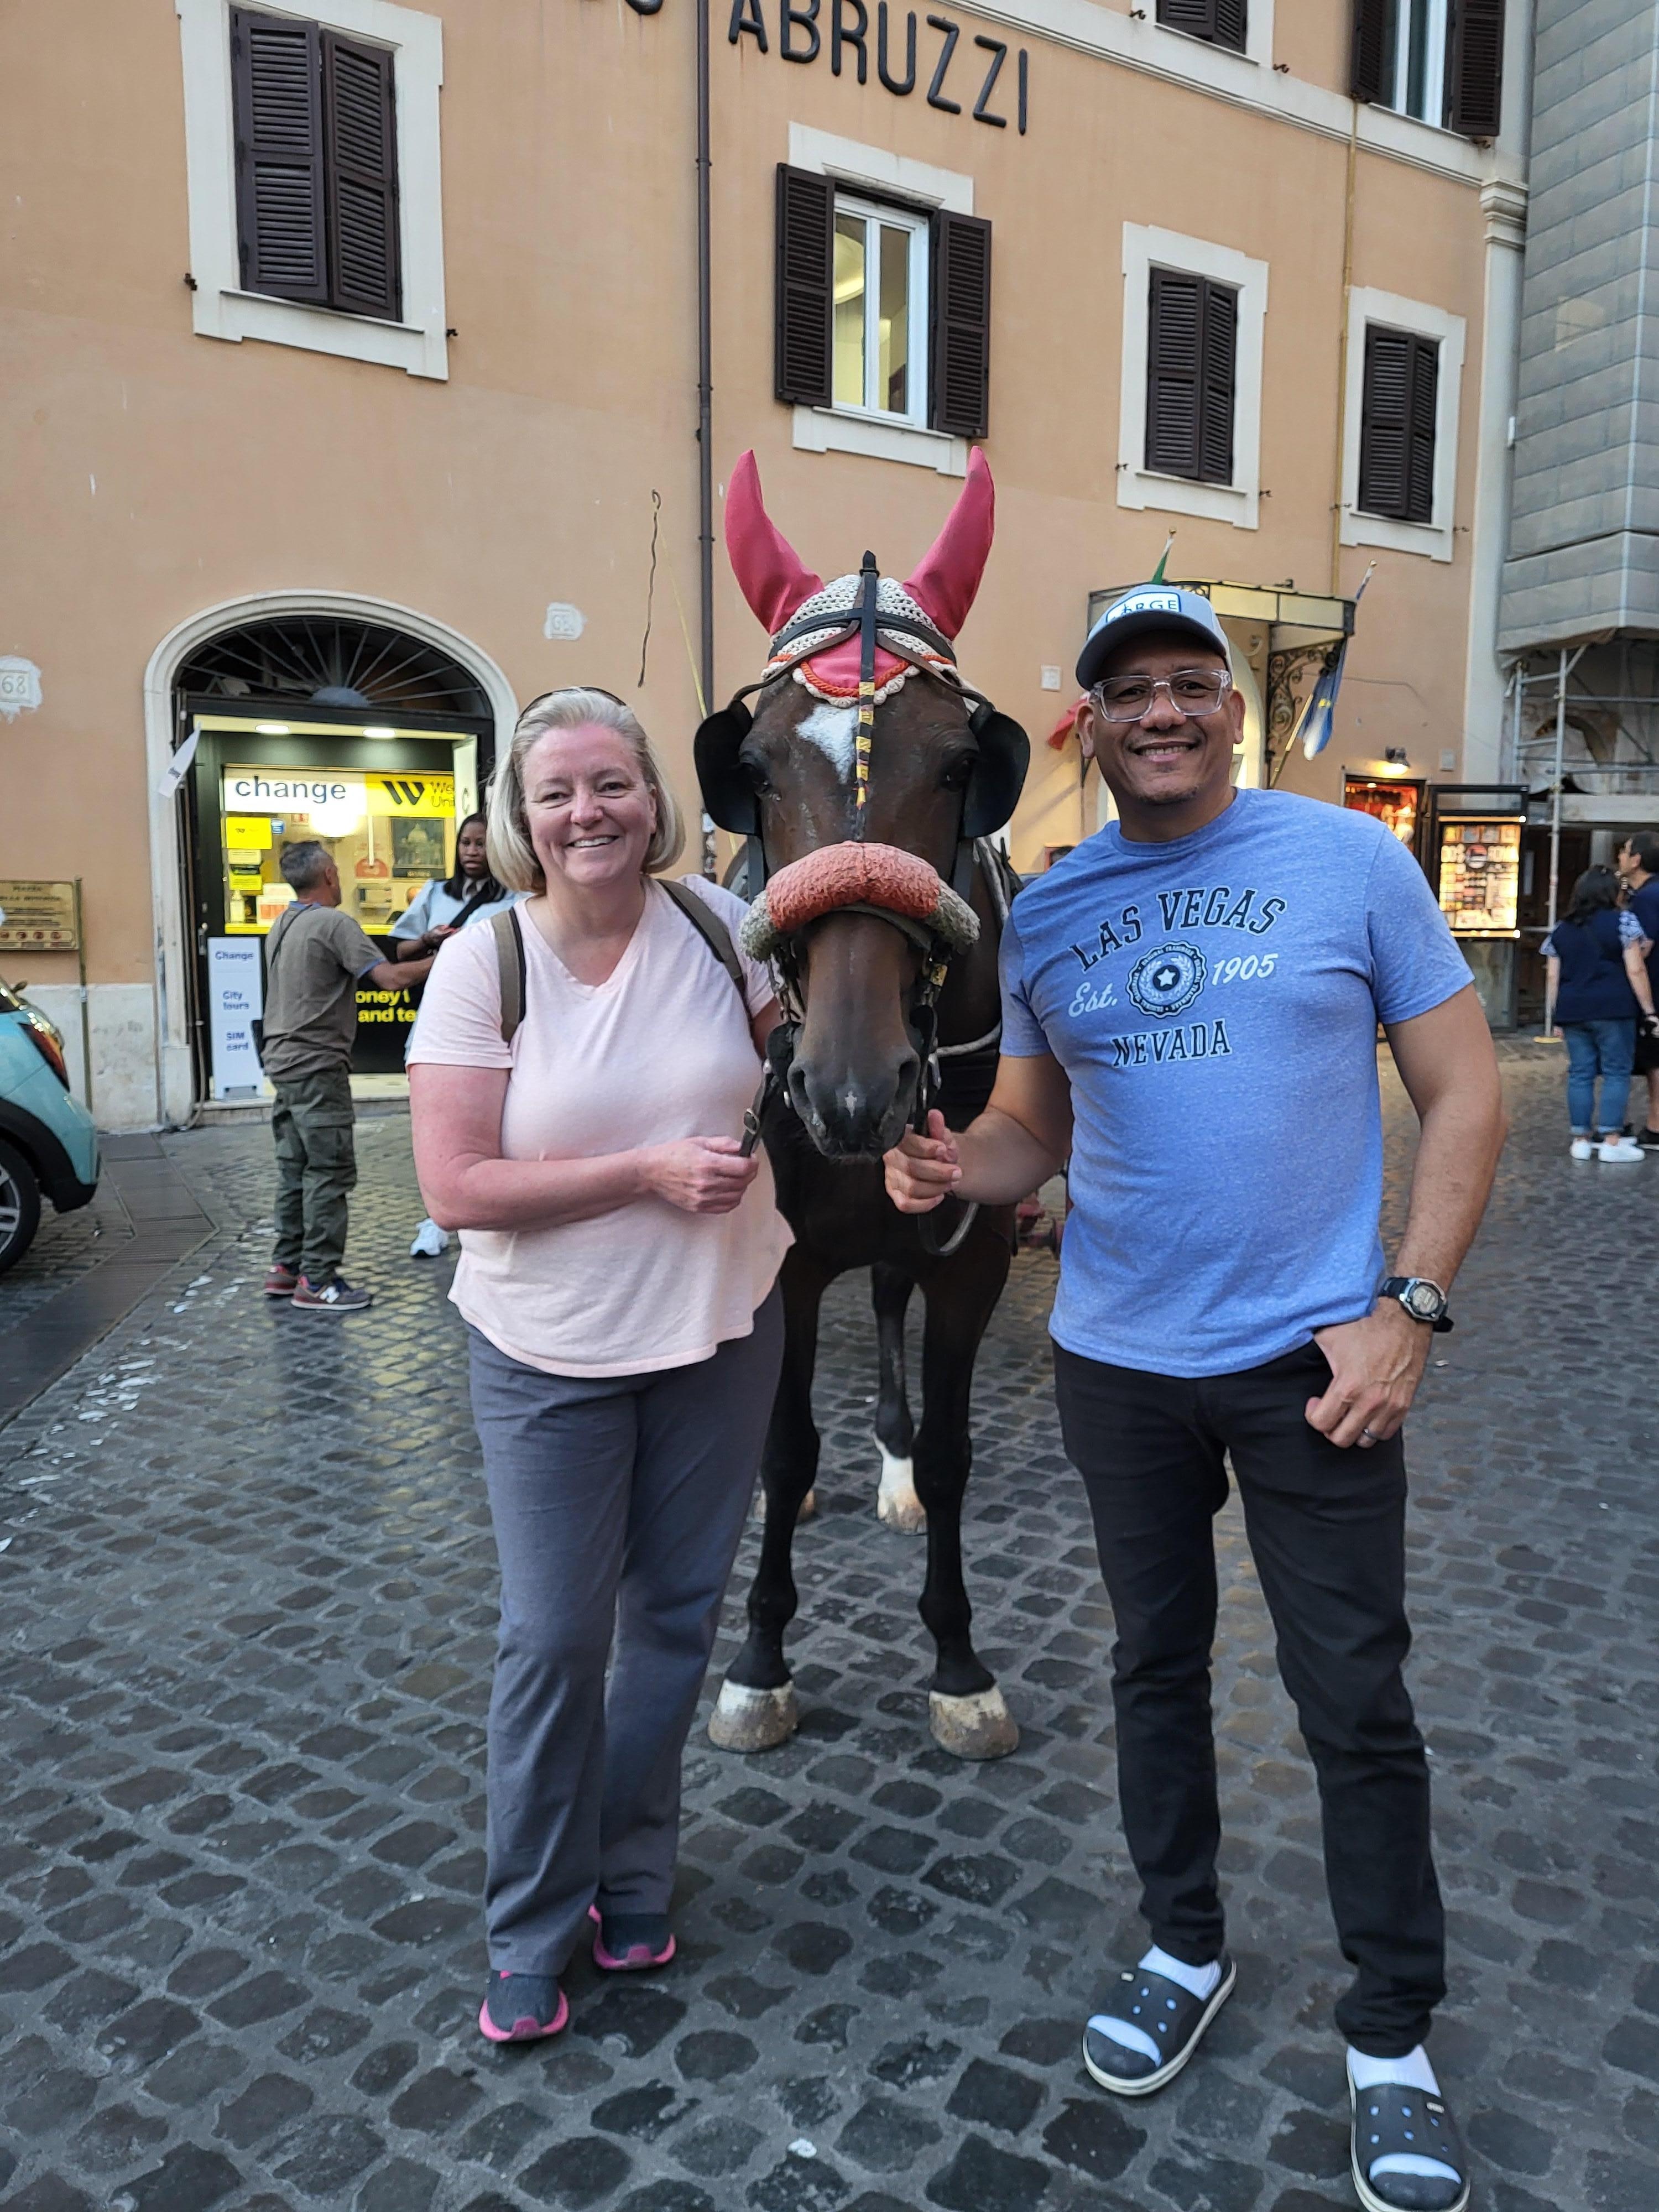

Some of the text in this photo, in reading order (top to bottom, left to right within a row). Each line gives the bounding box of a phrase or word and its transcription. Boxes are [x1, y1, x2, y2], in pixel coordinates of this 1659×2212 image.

[728, 0, 1027, 136] ABRUZZI
[2, 675, 27, 695] 68
[236, 775, 346, 804] change
[430, 782, 455, 794] We
[1070, 886, 1287, 972] LAS VEGAS
[355, 990, 401, 1006] oney
[1068, 982, 1118, 1018] Est.
[1212, 953, 1279, 986] 1905
[357, 1006, 395, 1023] and
[1112, 1019, 1232, 1068] NEVADA
